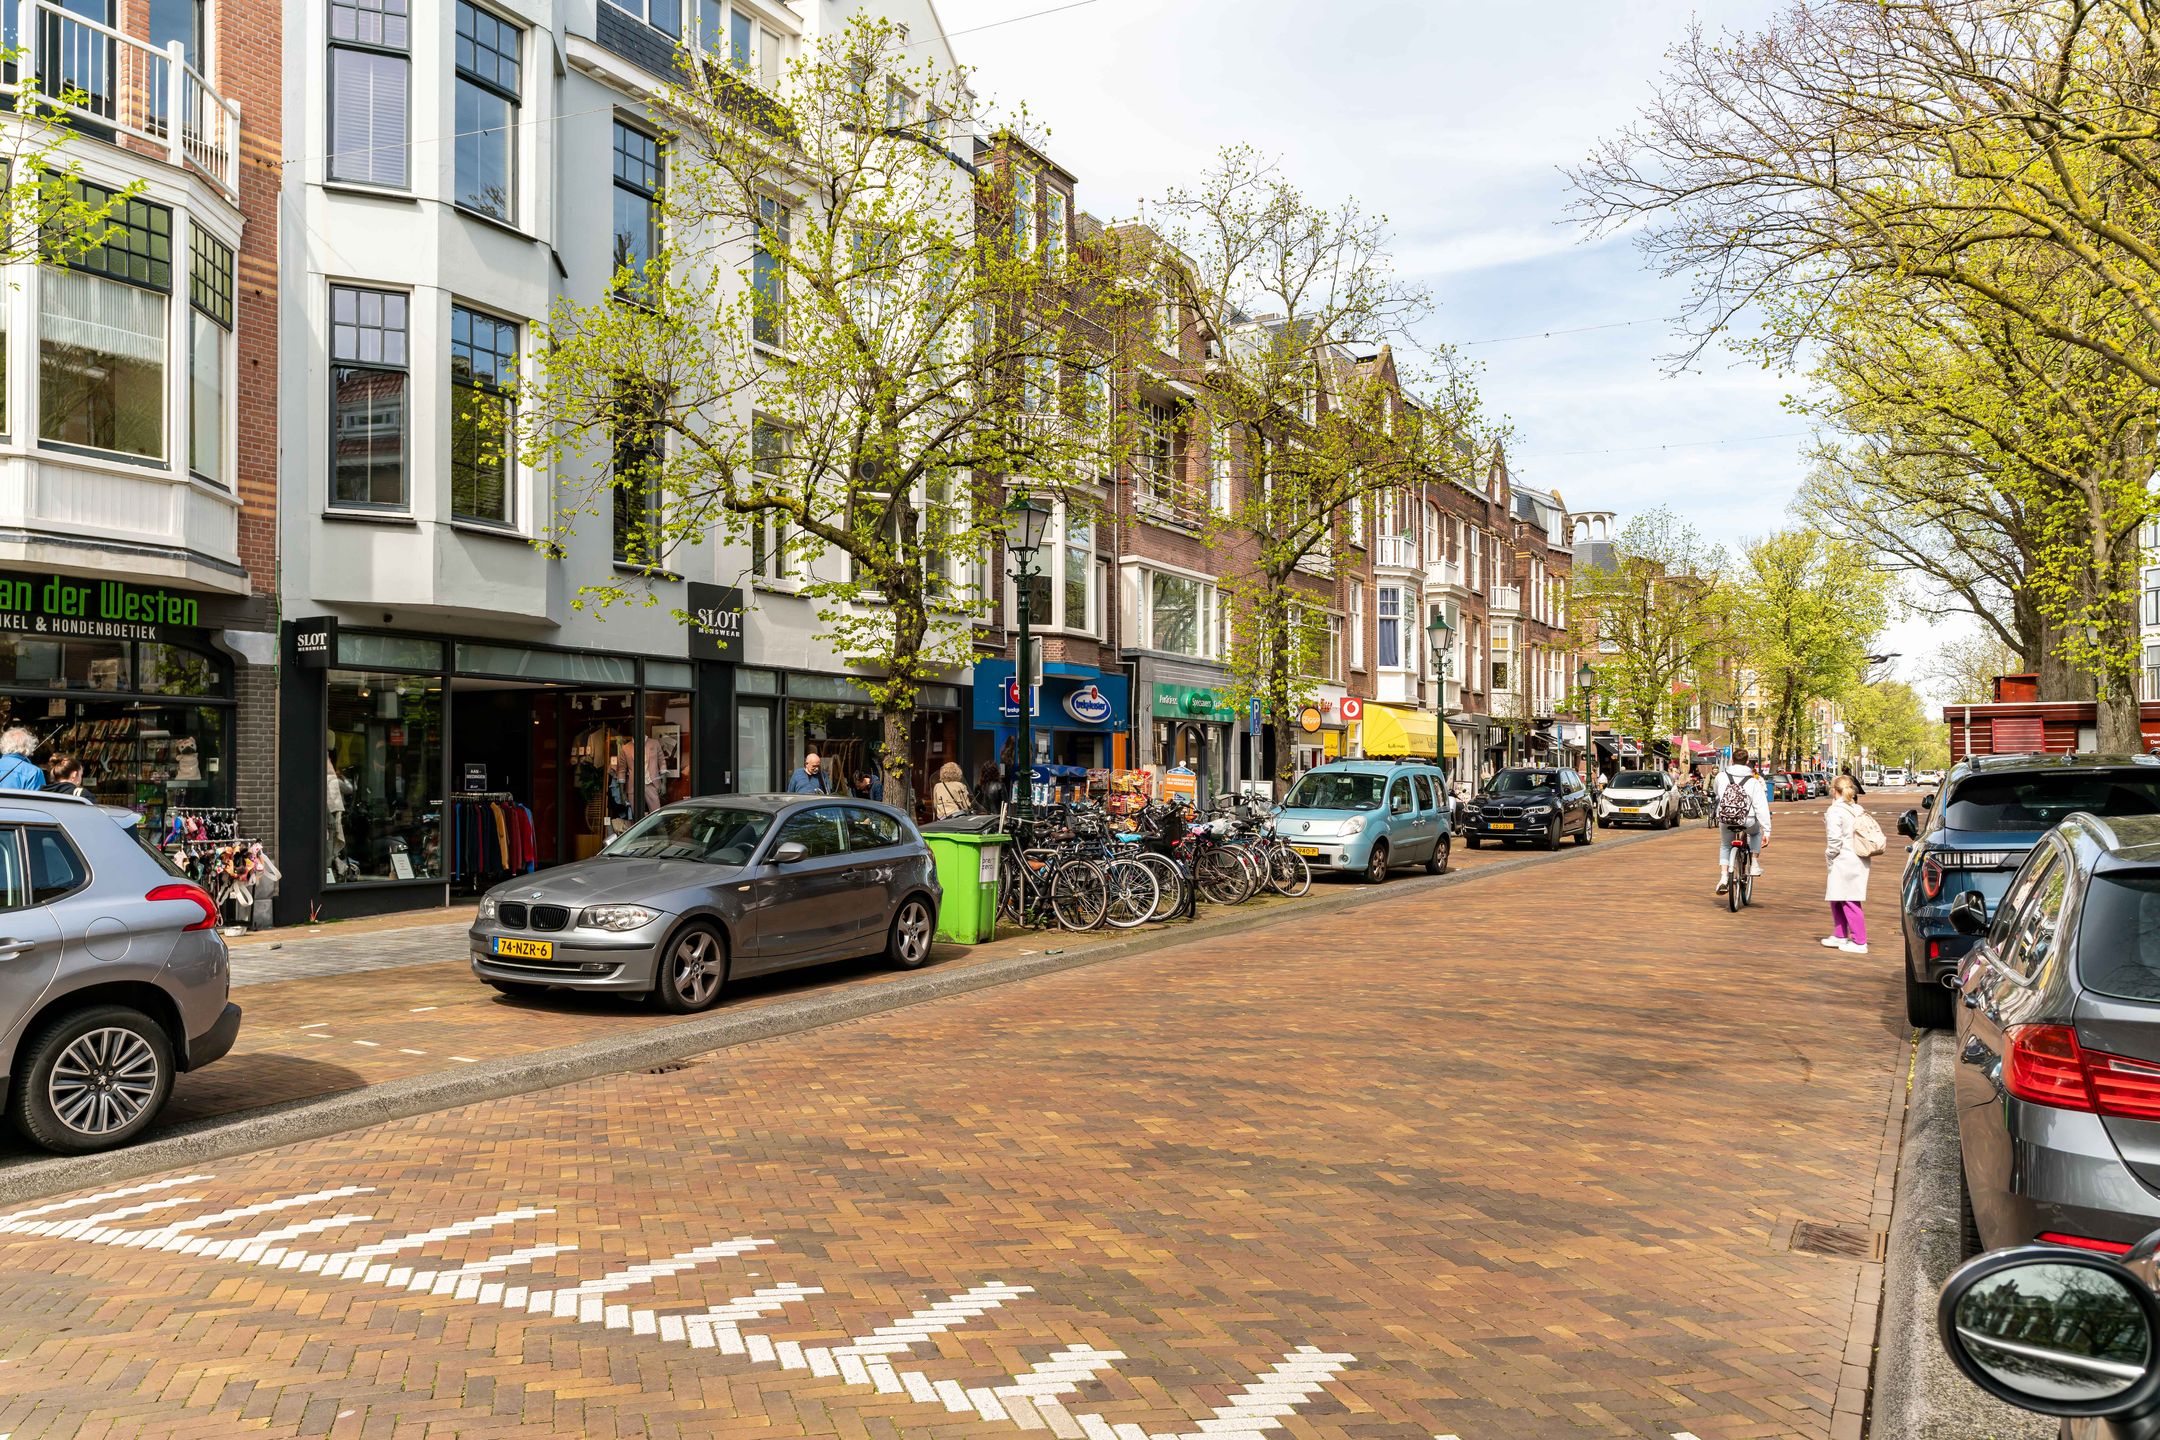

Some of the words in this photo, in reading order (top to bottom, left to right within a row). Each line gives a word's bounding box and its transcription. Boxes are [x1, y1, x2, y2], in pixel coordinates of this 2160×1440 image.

[43, 575, 92, 617] der
[100, 581, 198, 626] Westen
[0, 617, 28, 630] KEL
[35, 616, 48, 632] &
[52, 618, 156, 640] HONDENBOETIEK
[697, 608, 740, 630] SLOT
[297, 632, 328, 647] SLOT
[1254, 701, 1260, 720] P
[501, 940, 548, 957] 74-NZR-6
